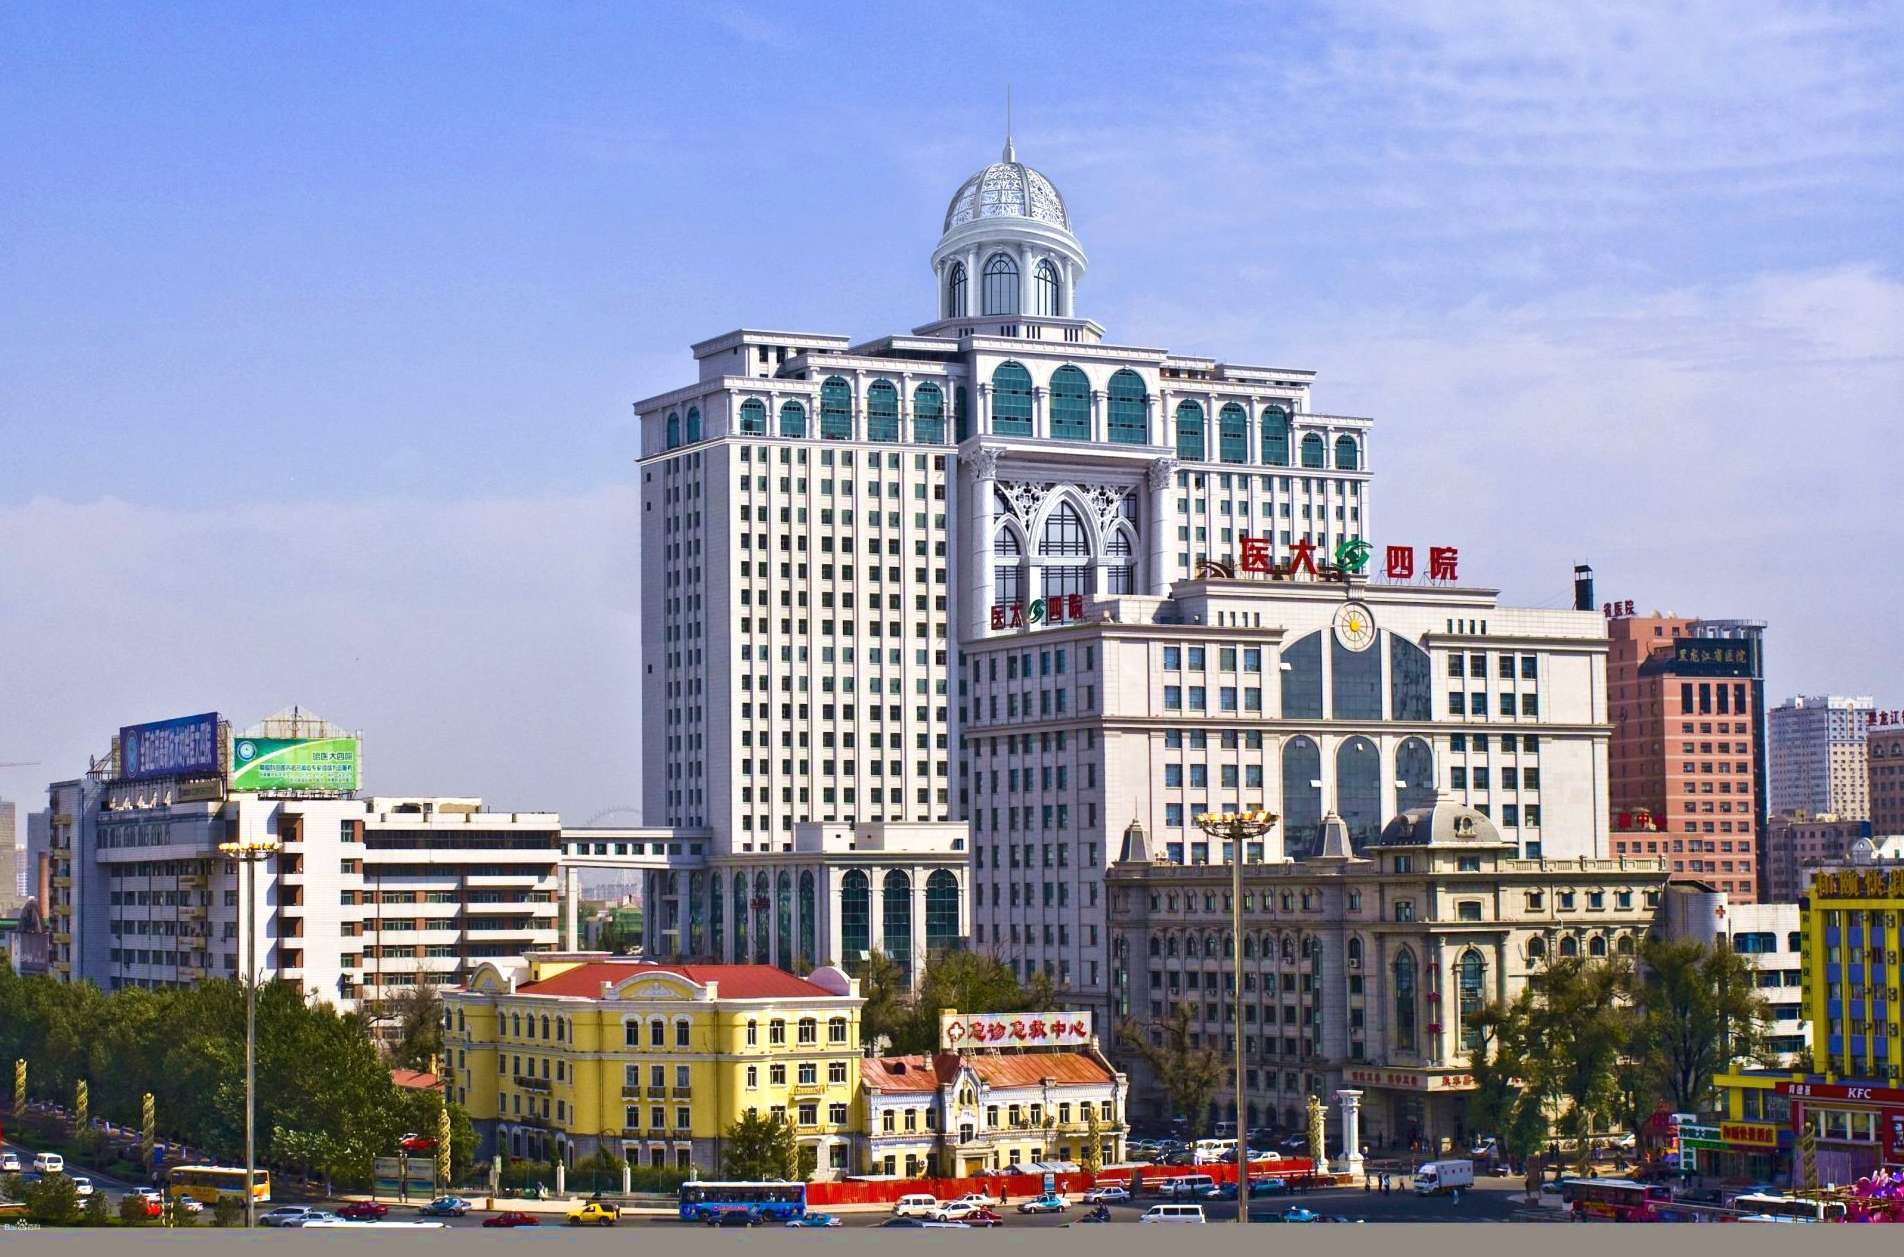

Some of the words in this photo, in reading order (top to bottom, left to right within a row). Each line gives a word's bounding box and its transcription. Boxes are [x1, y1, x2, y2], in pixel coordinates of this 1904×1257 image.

[969, 1019, 1087, 1042] 急诊急救中心
[1848, 1087, 1872, 1099] KFC
